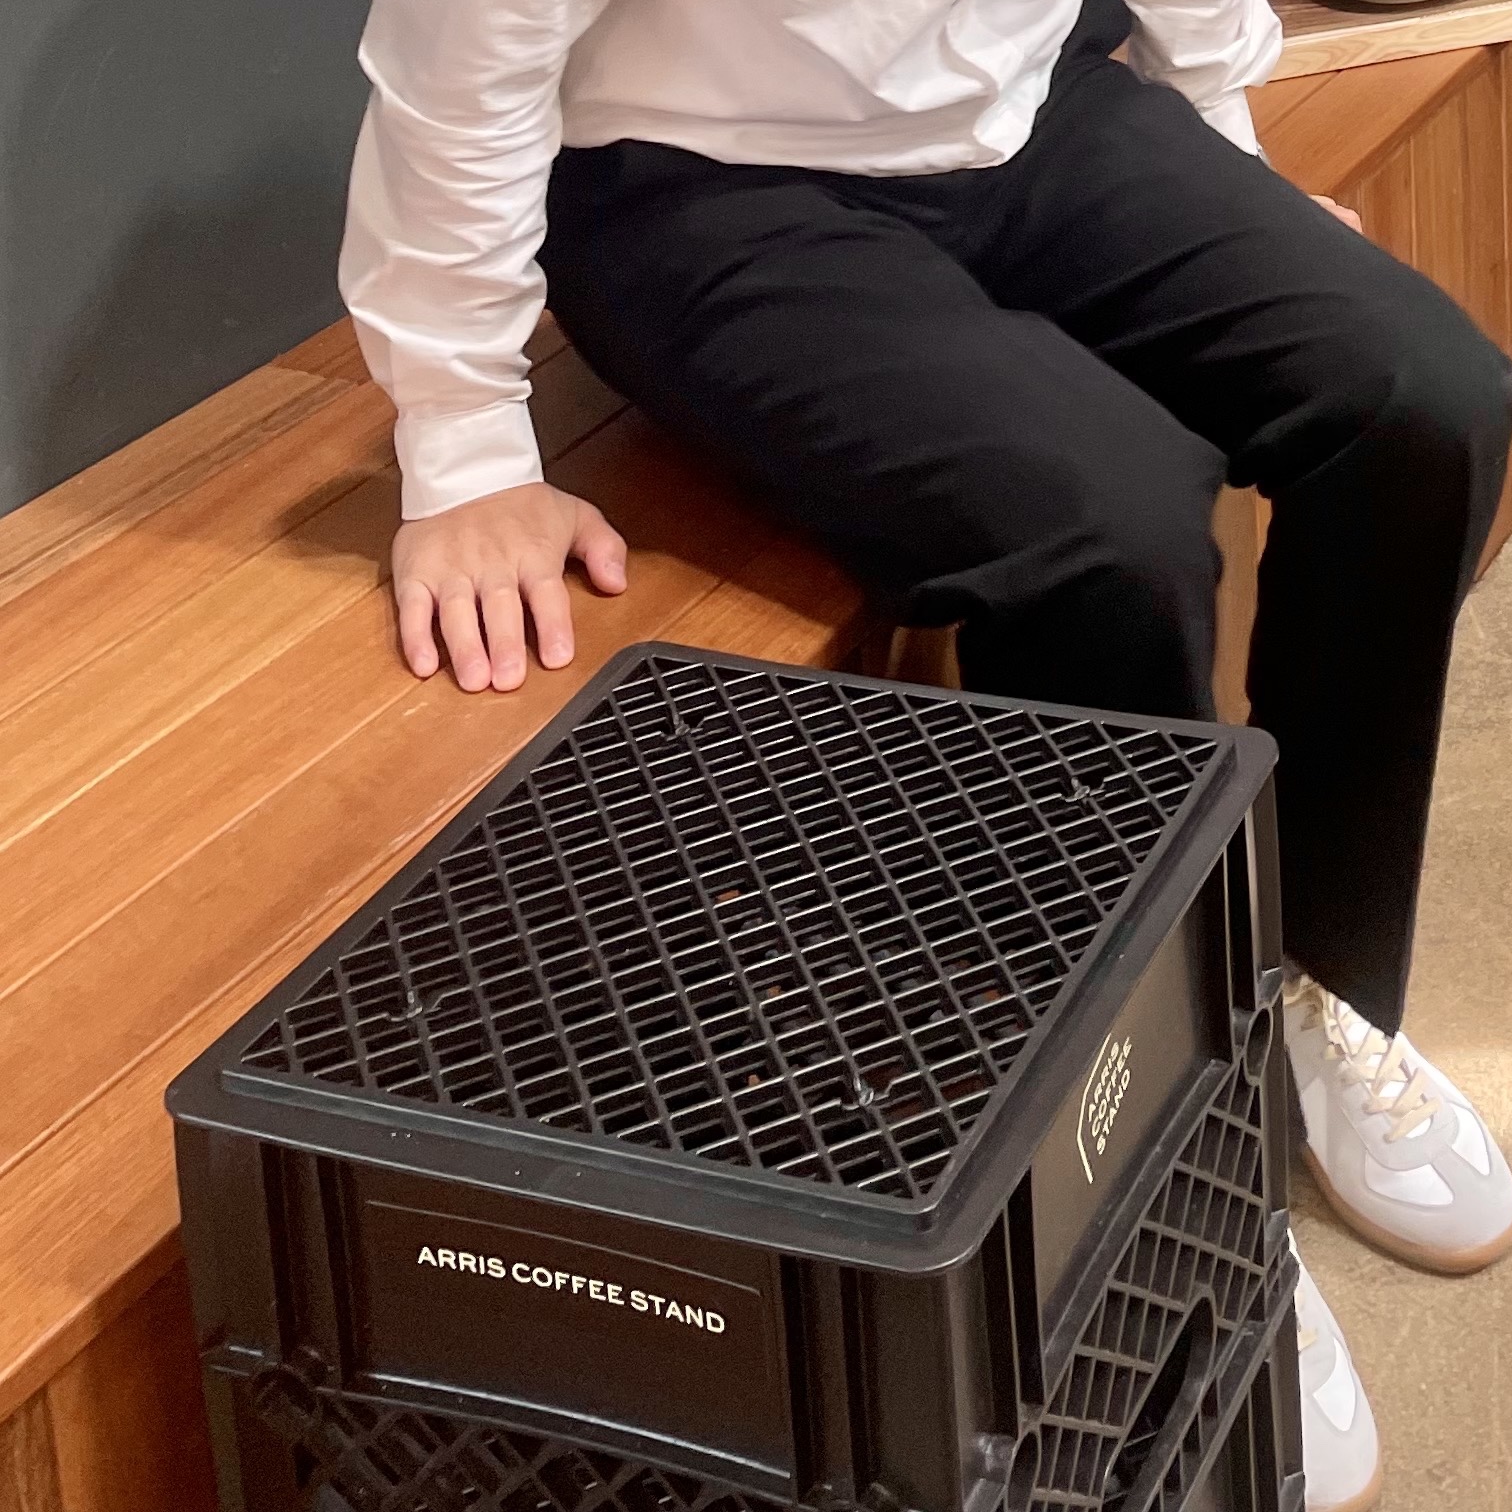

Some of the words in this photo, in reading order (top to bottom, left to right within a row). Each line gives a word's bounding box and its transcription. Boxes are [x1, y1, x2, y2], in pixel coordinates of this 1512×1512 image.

[1087, 1040, 1121, 1123] ARRIS
[1091, 1035, 1133, 1138] COFFEE
[1096, 1067, 1131, 1156] STAND
[416, 1245, 507, 1279] ARRIS
[510, 1261, 626, 1306] COFFEE
[629, 1289, 726, 1334] STAND
